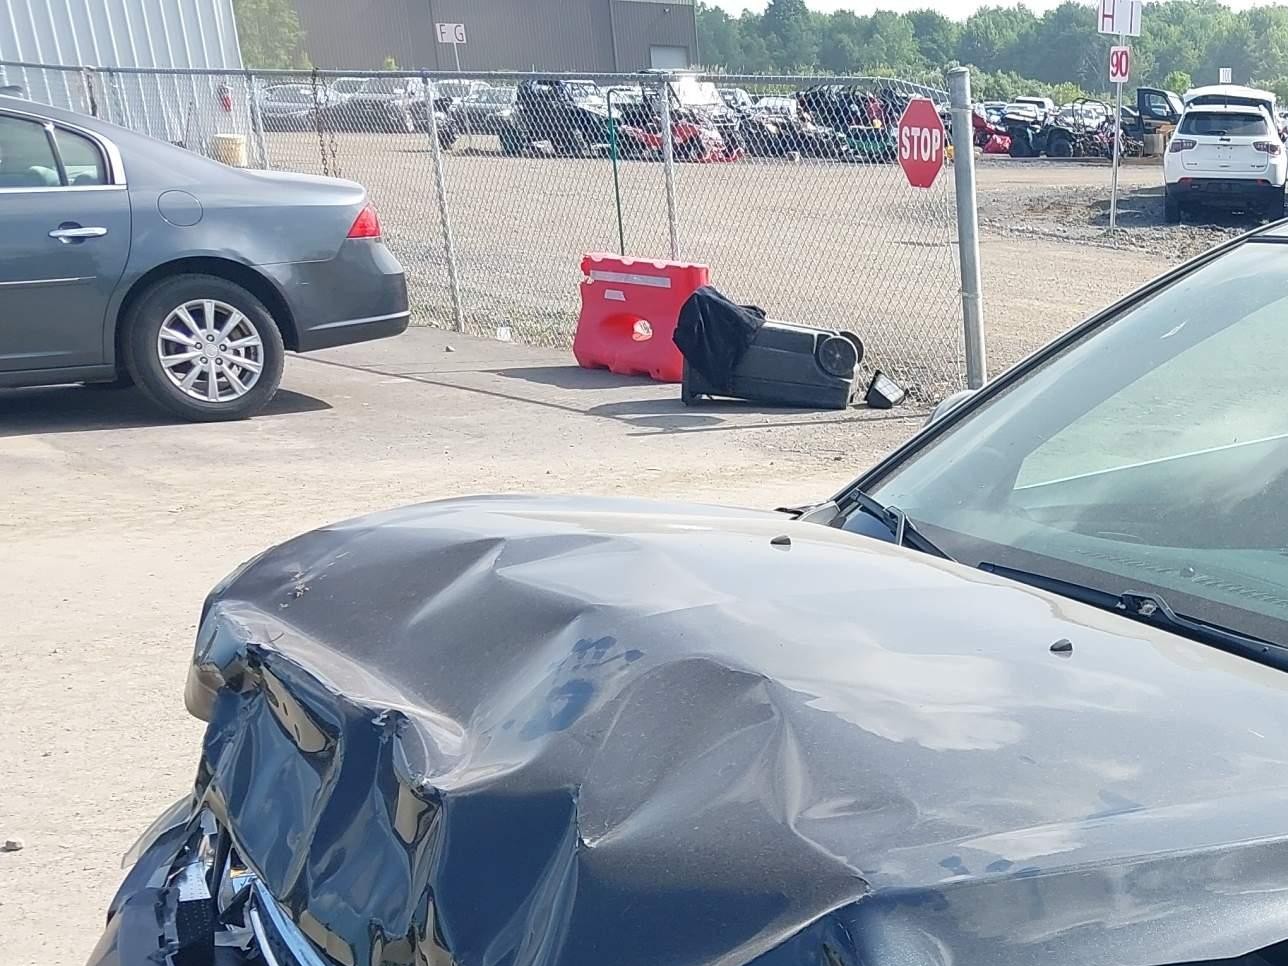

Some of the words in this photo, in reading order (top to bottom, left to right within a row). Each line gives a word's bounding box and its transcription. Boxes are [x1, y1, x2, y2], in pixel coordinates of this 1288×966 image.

[439, 24, 447, 41] F
[454, 24, 465, 42] G
[1110, 50, 1129, 77] 90
[901, 126, 941, 162] STOP
